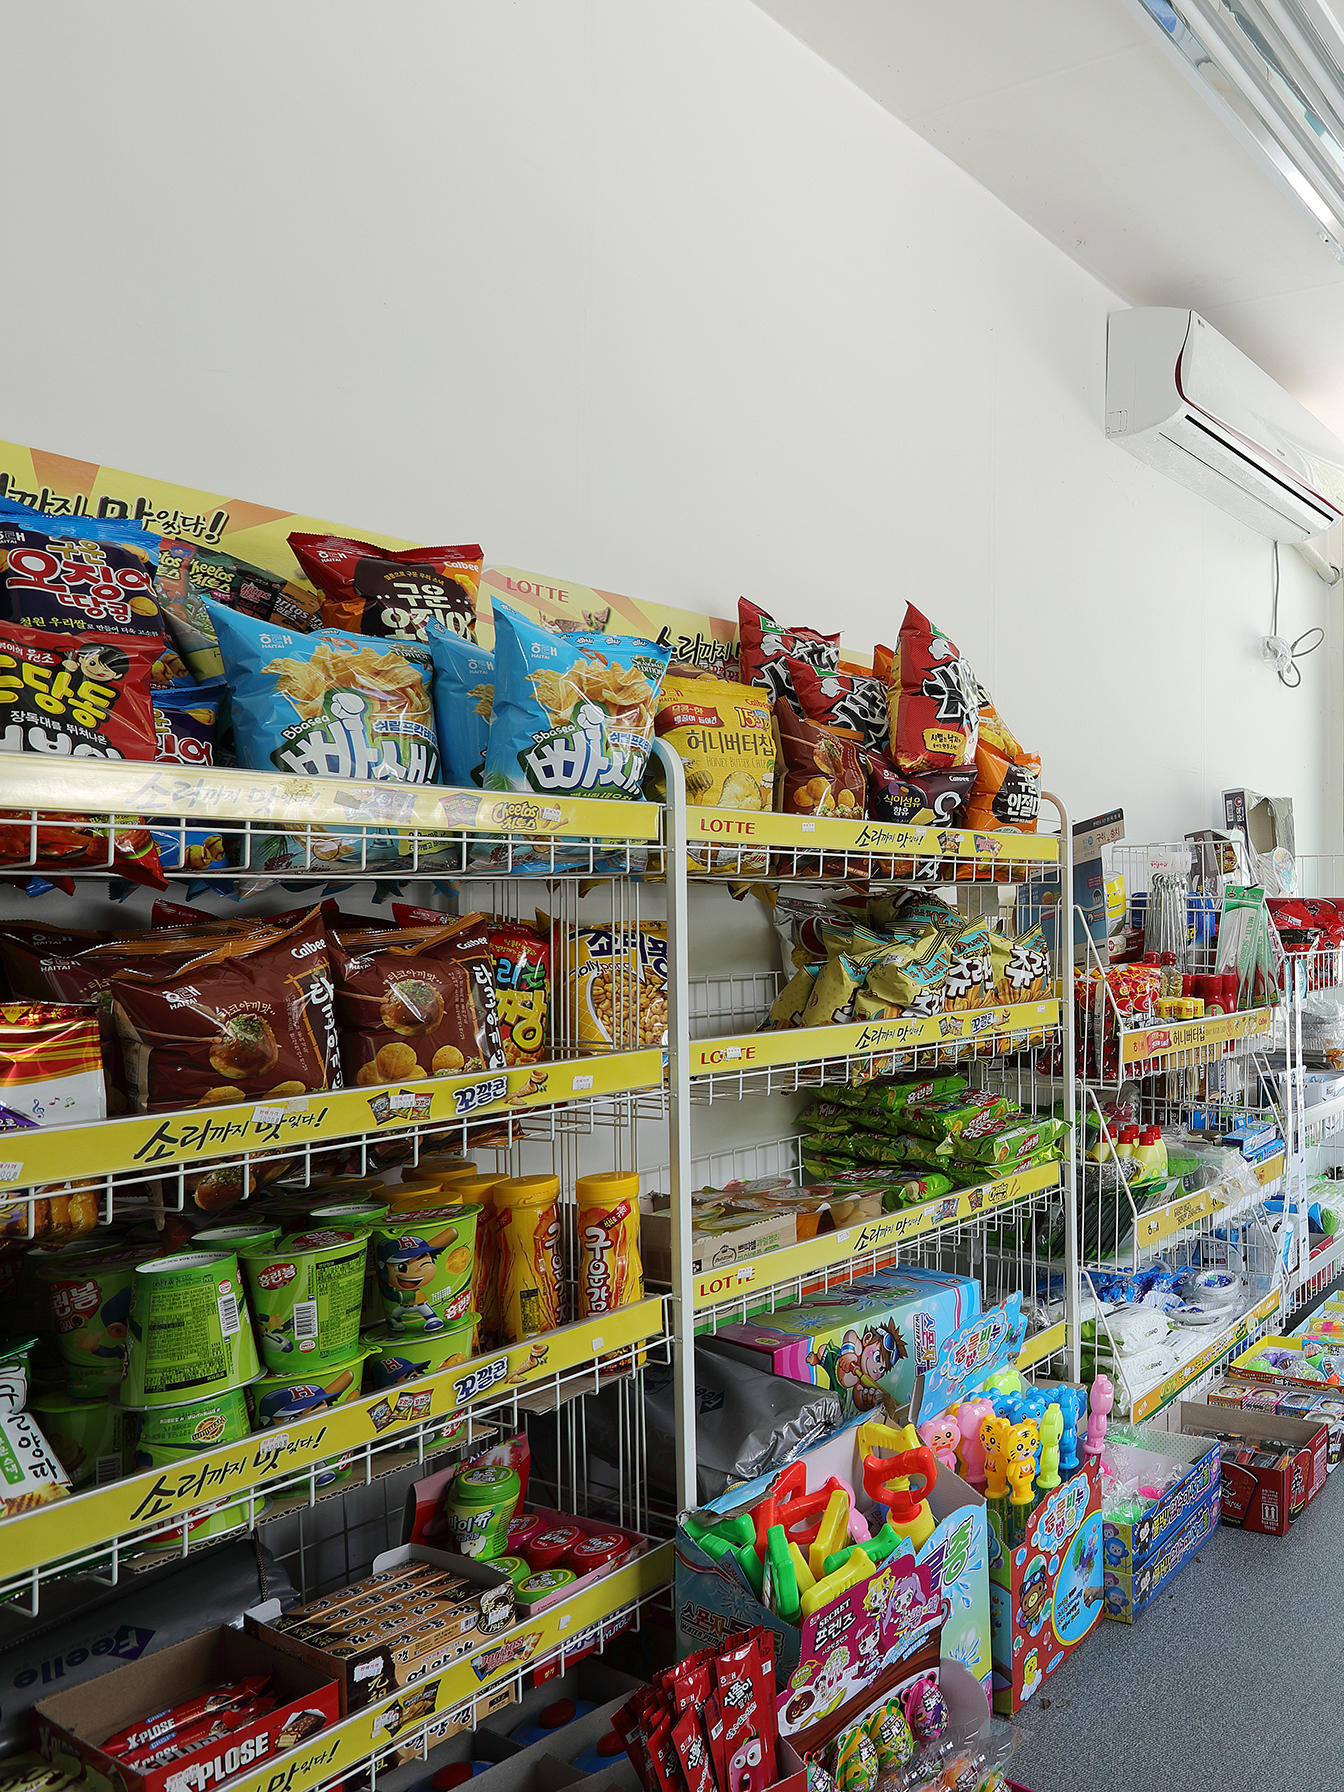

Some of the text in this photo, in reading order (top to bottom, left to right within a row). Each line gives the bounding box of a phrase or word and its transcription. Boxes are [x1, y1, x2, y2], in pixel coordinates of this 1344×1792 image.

[46, 536, 107, 566] 구운
[6, 548, 158, 602] 오징어
[443, 560, 480, 573] Calbee
[393, 582, 451, 609] 구운
[506, 577, 569, 603] LOTTE
[57, 593, 132, 624] 땅콩
[282, 714, 331, 741] Bbasea
[686, 729, 775, 757] 허니버터칩
[706, 756, 729, 769] HONEY
[493, 801, 538, 821] Cheetos
[884, 793, 922, 808] 식이섬유
[893, 806, 910, 817] 함유
[501, 817, 538, 832] 치토스
[700, 818, 756, 836] LOTTE
[855, 825, 896, 848] 소리까지
[291, 938, 328, 960] Calbee
[40, 964, 71, 972] HAITAI
[855, 1026, 896, 1051] 소리까지
[1172, 1024, 1206, 1047] 허니버터칩
[700, 1046, 755, 1065] LOTTE
[453, 1077, 507, 1114] 꼬깔콘
[133, 1114, 251, 1164] 소리까지
[399, 1236, 419, 1251] H
[853, 1223, 895, 1252] 소리까지
[258, 1264, 298, 1288] 홈런볼
[584, 1226, 614, 1318] 구운감
[384, 1357, 403, 1372] H
[290, 1385, 313, 1400] H
[454, 1357, 508, 1404] 꼬깔콘
[129, 1456, 248, 1522] 소리까지
[818, 1599, 851, 1628] SECRET
[703, 1632, 721, 1650] PUM
[815, 1612, 857, 1652] 프렌즈
[126, 1718, 177, 1751] X-PLOSE
